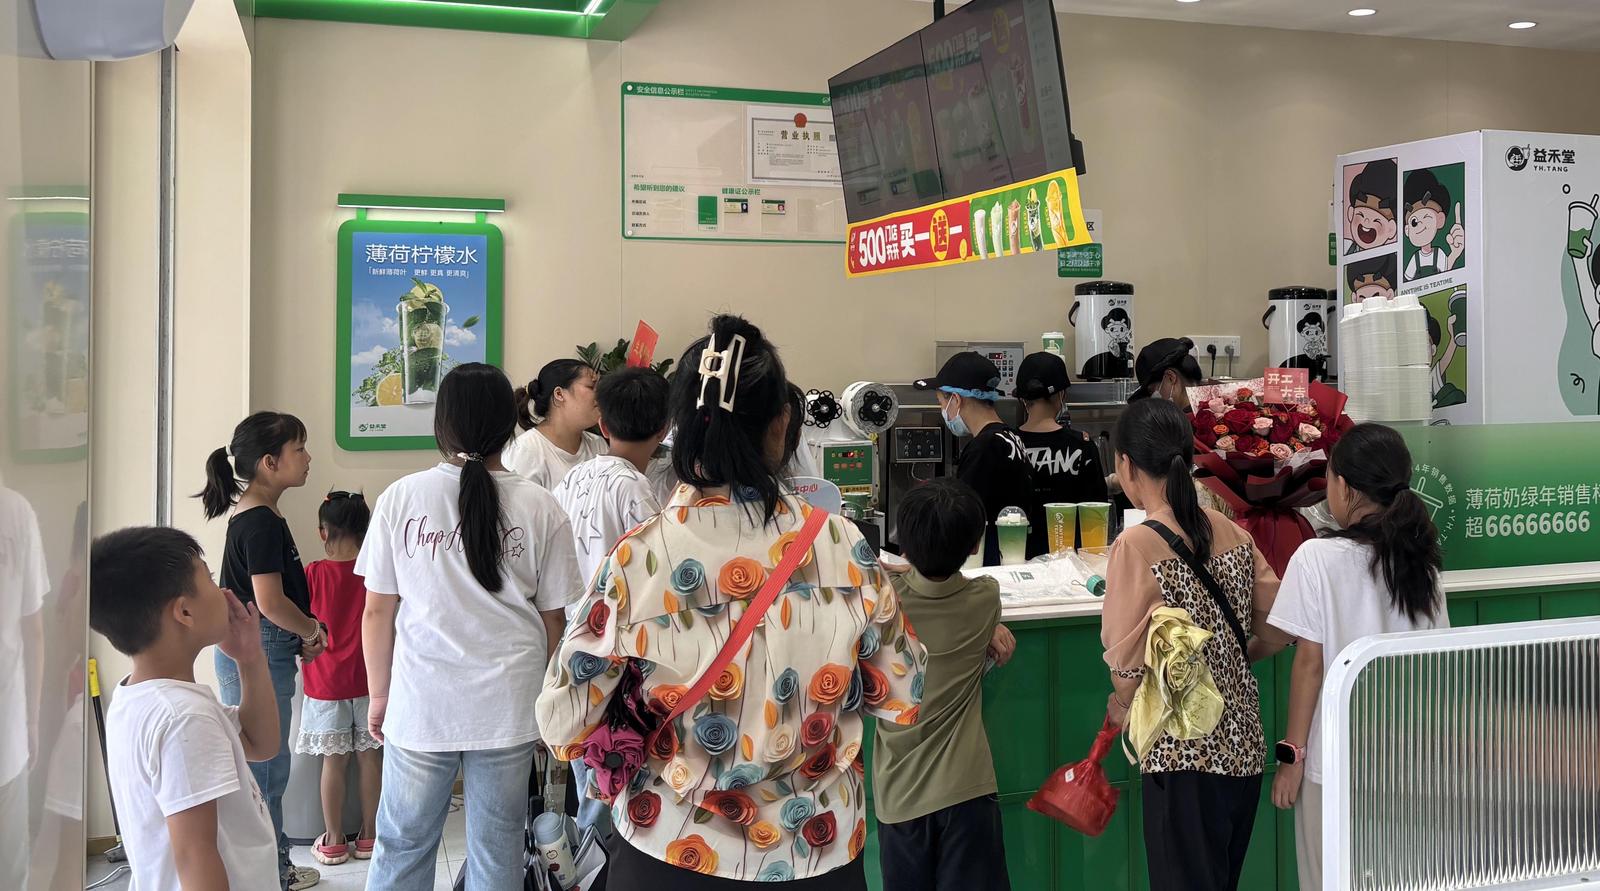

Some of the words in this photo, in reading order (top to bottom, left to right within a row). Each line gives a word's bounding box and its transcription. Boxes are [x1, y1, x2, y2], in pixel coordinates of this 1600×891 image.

[636, 86, 684, 96] 安全信息公示栏
[780, 130, 821, 141] 营业执照
[1533, 148, 1576, 164] 益禾堂
[633, 183, 686, 193] 希望听到您的建议
[365, 243, 479, 265] 薄荷柠檬水
[859, 226, 887, 267] 500
[1400, 286, 1423, 296] ANYTIME
[1430, 277, 1453, 288] TEATIME
[1267, 373, 1294, 385] 开工
[1280, 385, 1306, 399] 大吉
[1411, 463, 1457, 505] 4年销售数据
[1436, 515, 1456, 546] YH.TA
[1465, 510, 1591, 539] 超66666666
